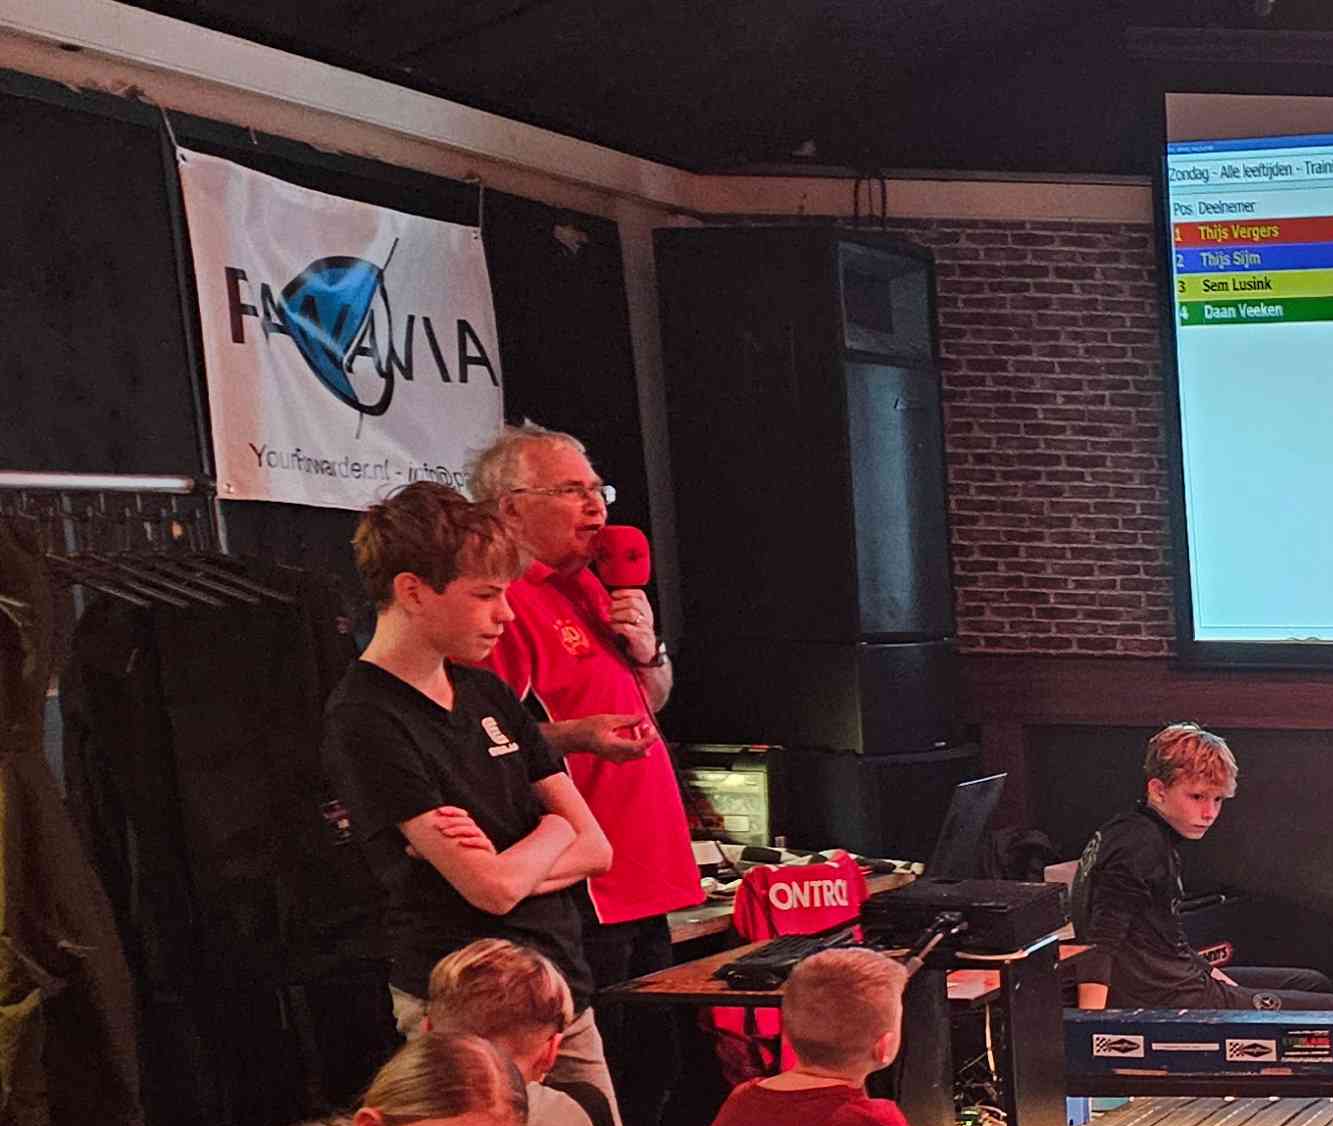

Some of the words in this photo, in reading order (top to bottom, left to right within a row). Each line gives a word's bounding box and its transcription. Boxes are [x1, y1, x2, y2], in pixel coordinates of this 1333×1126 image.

[1169, 166, 1209, 183] Zondag
[1220, 164, 1240, 179] Alle
[1242, 161, 1293, 180] leeftijden
[1198, 200, 1257, 216] Deelnemer
[1175, 227, 1183, 242] 1
[1199, 225, 1229, 243] Thijs
[1232, 224, 1280, 242] Vergers
[1176, 255, 1184, 268] 2
[1201, 251, 1231, 269] Thijs
[1233, 250, 1262, 268] Sijm
[1178, 280, 1186, 294] 3
[1203, 277, 1229, 293] Sem
[1232, 275, 1272, 292] Lusink
[1180, 306, 1189, 320] 4
[1204, 303, 1237, 319] Daan
[1238, 301, 1284, 318] Veeken
